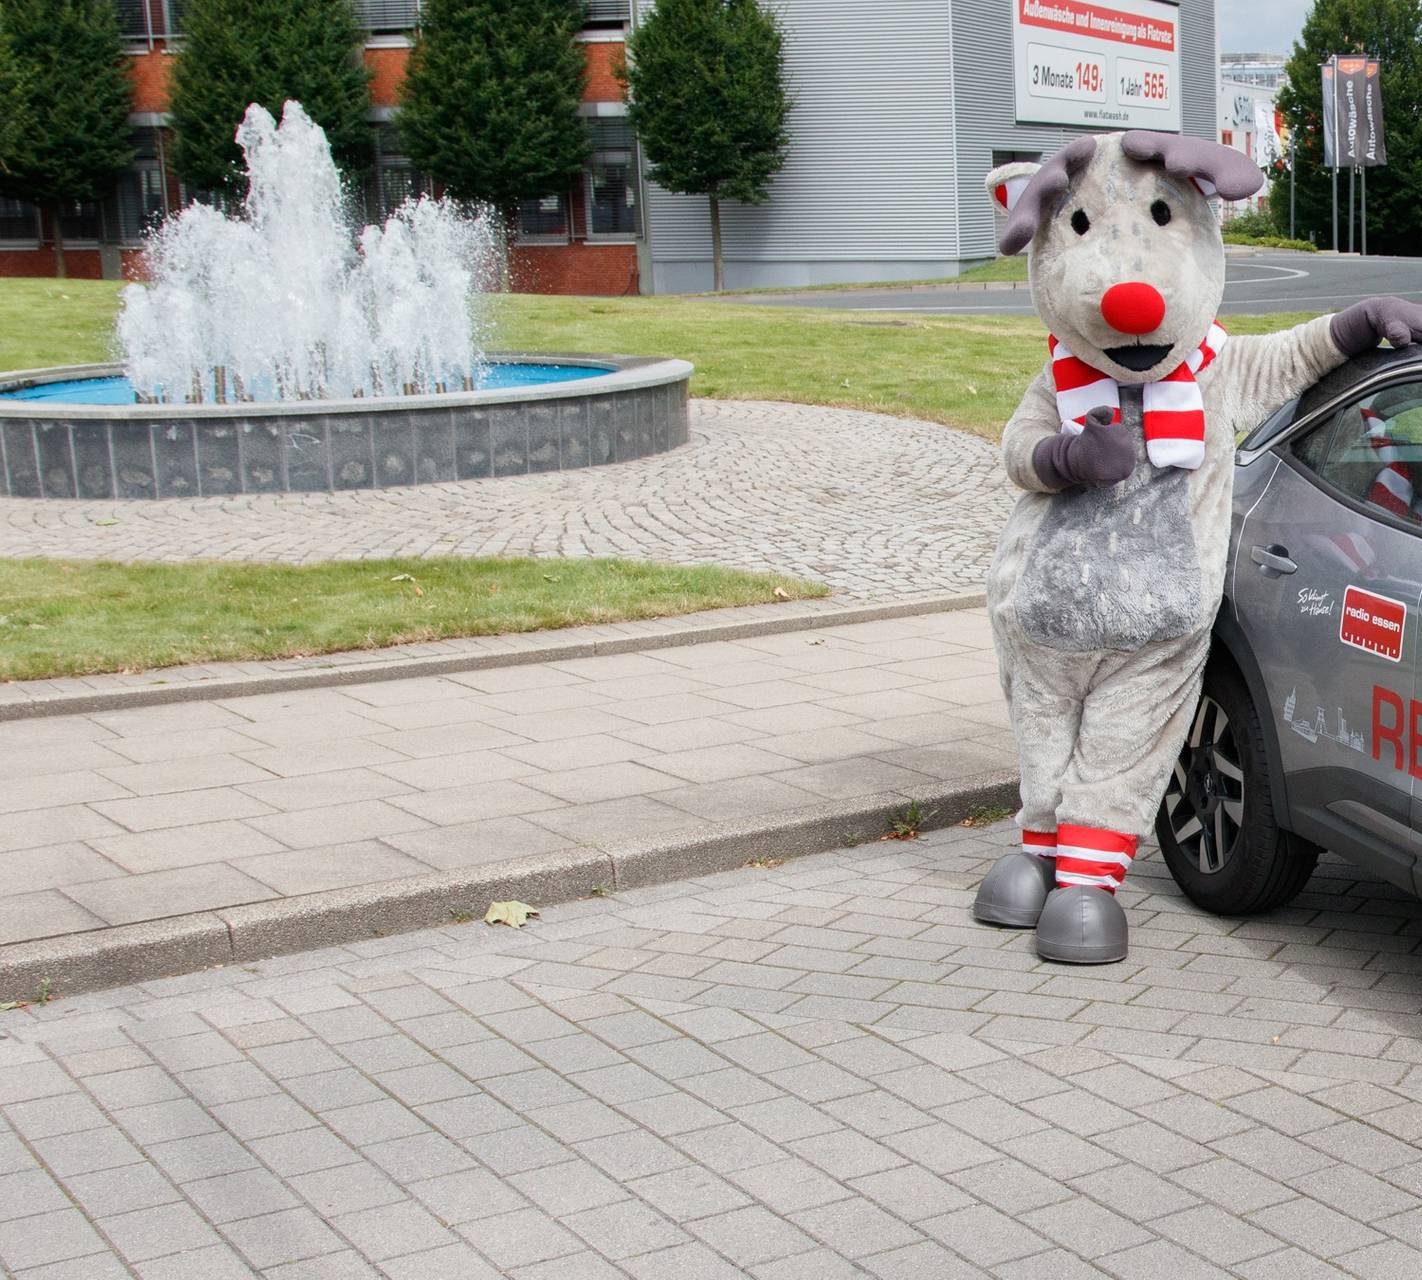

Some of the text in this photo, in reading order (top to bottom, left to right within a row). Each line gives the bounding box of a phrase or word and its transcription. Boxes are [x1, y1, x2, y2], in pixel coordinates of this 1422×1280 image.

[1023, 0, 1075, 25] Außenwäsche
[1075, 11, 1090, 28] und
[1090, 11, 1137, 42] Innenreinigung
[1137, 24, 1147, 40] als
[1032, 64, 1040, 85] 3
[1041, 65, 1074, 89] Monate
[1120, 77, 1125, 96] 1
[1126, 77, 1142, 97] Jahr
[1296, 587, 1308, 604] So
[1345, 606, 1400, 633] radio essen
